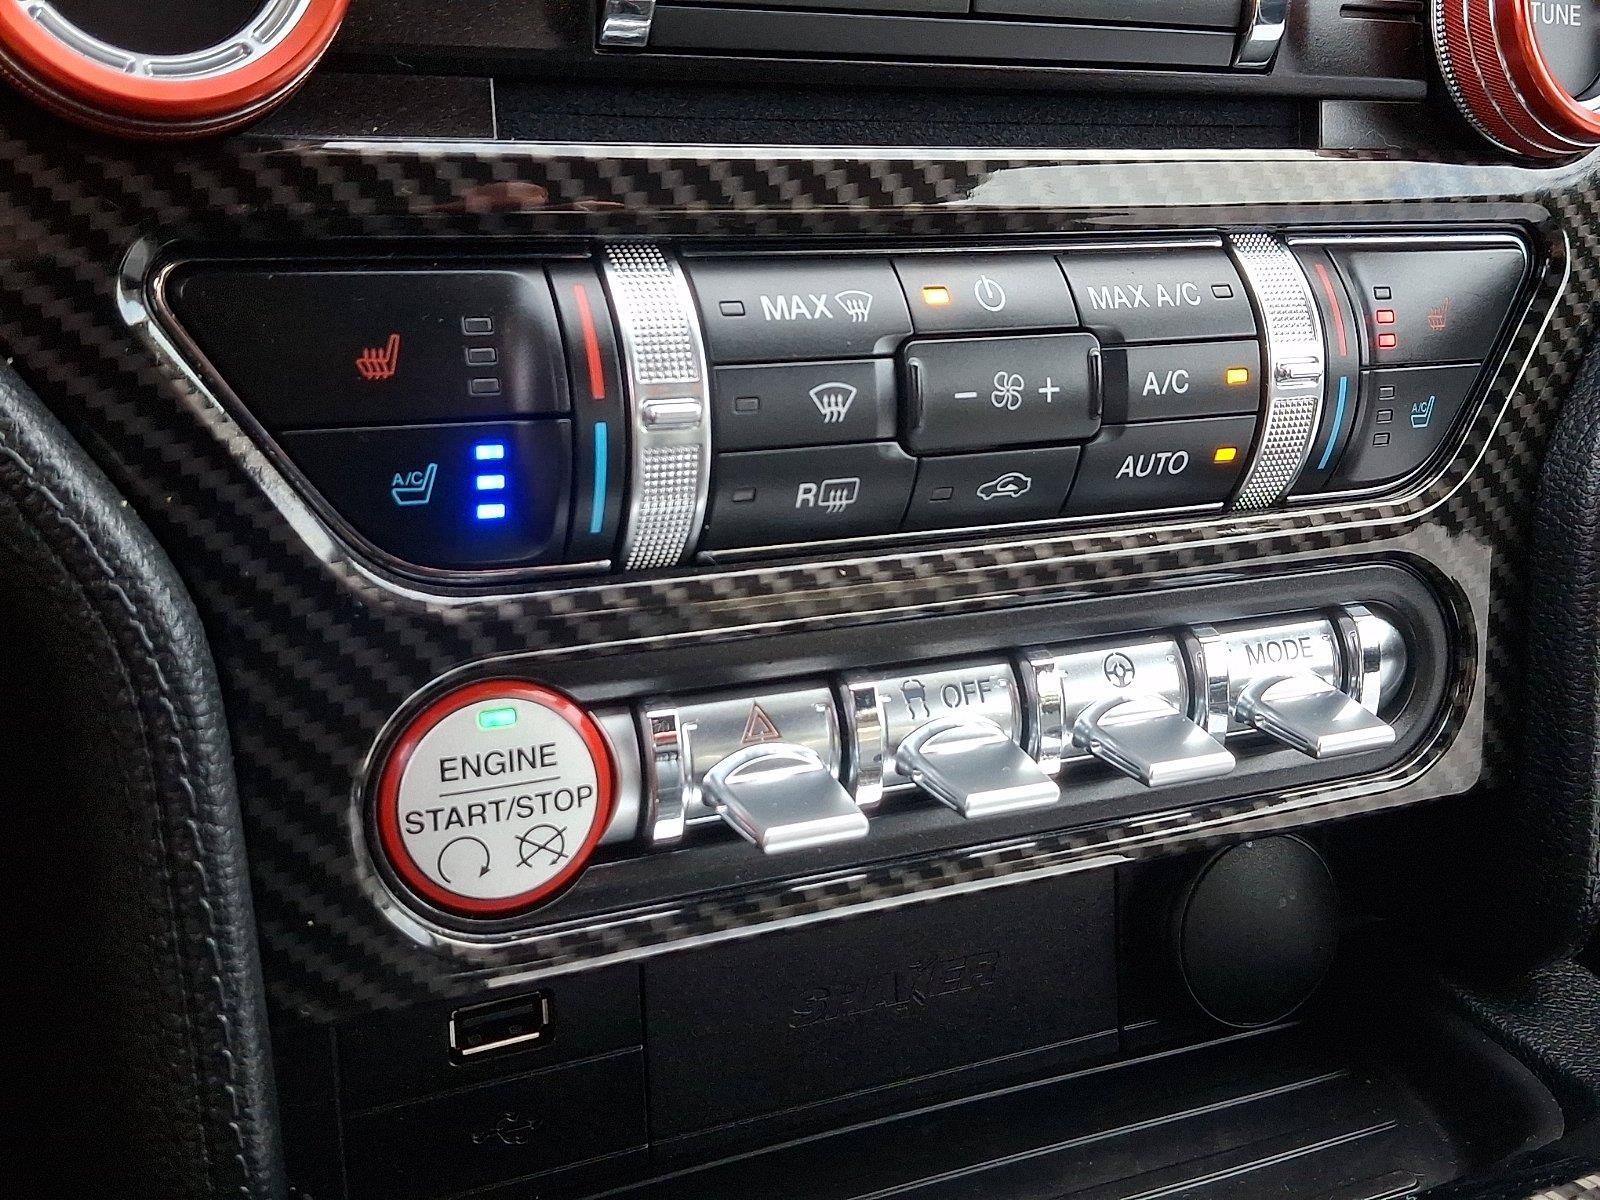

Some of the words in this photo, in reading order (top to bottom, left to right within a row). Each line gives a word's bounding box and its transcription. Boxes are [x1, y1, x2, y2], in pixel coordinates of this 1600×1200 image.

[1530, 1, 1581, 26] TUNE
[760, 293, 833, 321] MAX
[1087, 283, 1150, 310] MAX
[1156, 282, 1201, 307] A/C
[1142, 369, 1190, 396] A/C
[1411, 401, 1427, 412] A/C
[392, 471, 424, 486] A/C
[1115, 450, 1189, 479] AUTO
[795, 482, 817, 508] R
[1244, 636, 1313, 666] MODE
[941, 678, 992, 708] OFF
[439, 742, 558, 782] ENGINE
[405, 784, 593, 835] START/STOP
